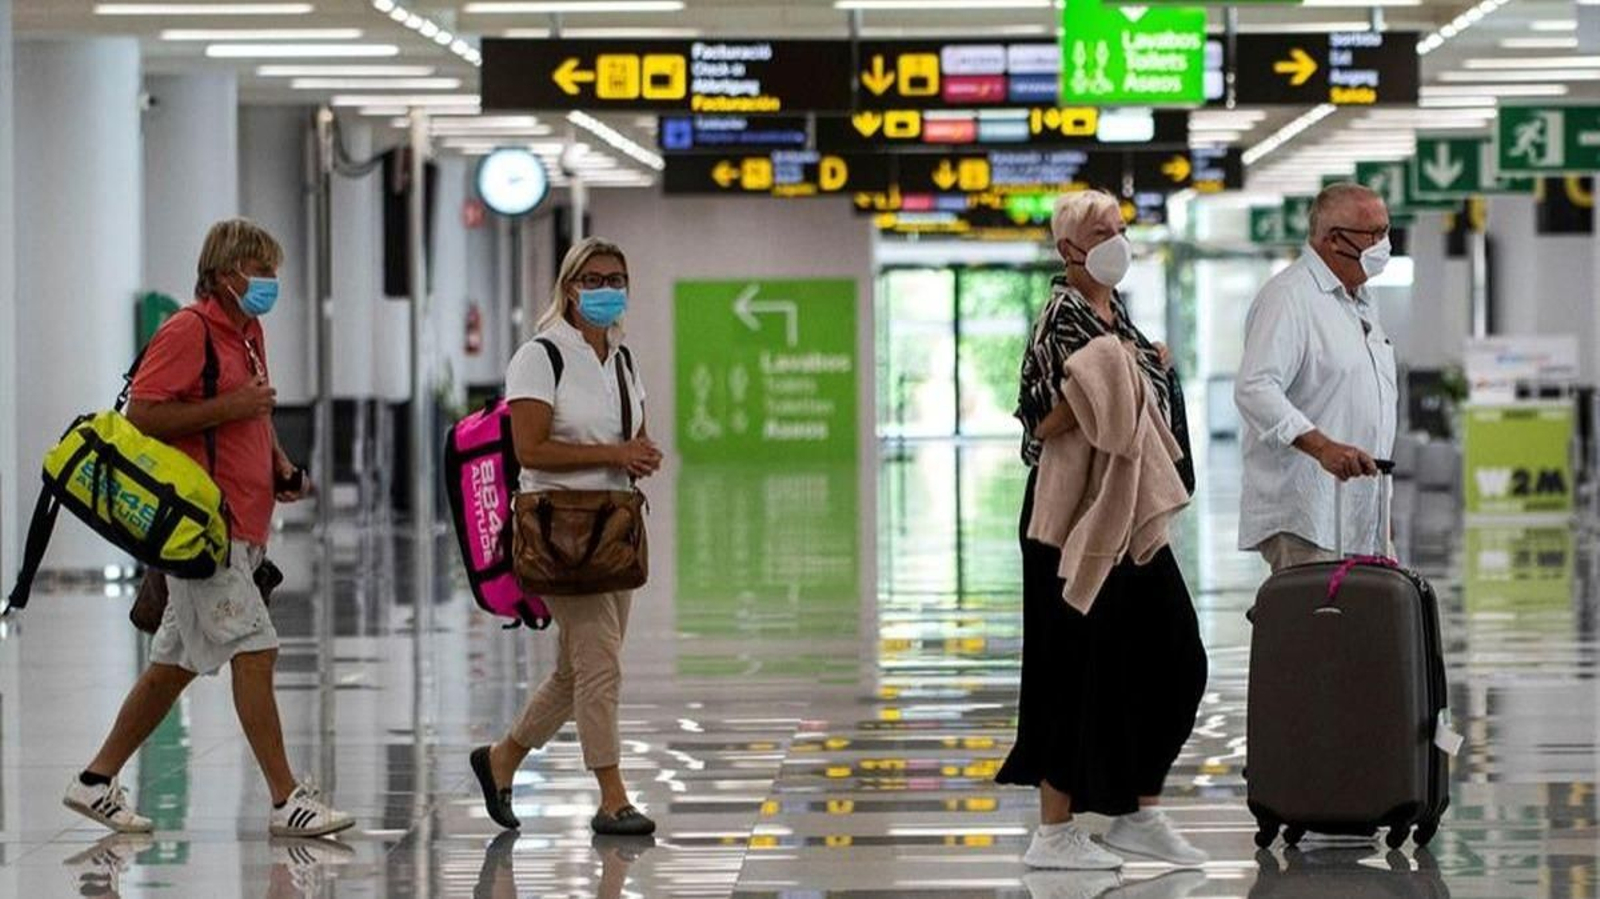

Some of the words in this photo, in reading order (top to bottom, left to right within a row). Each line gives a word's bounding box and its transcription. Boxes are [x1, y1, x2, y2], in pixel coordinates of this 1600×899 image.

[1121, 30, 1201, 50] Lavabos
[1126, 51, 1188, 71] Toilets
[1123, 72, 1182, 92] Aseos
[820, 156, 848, 191] D
[760, 351, 851, 373] Lavabos
[1475, 469, 1567, 497] W2M
[471, 464, 493, 565] ALTITUDE
